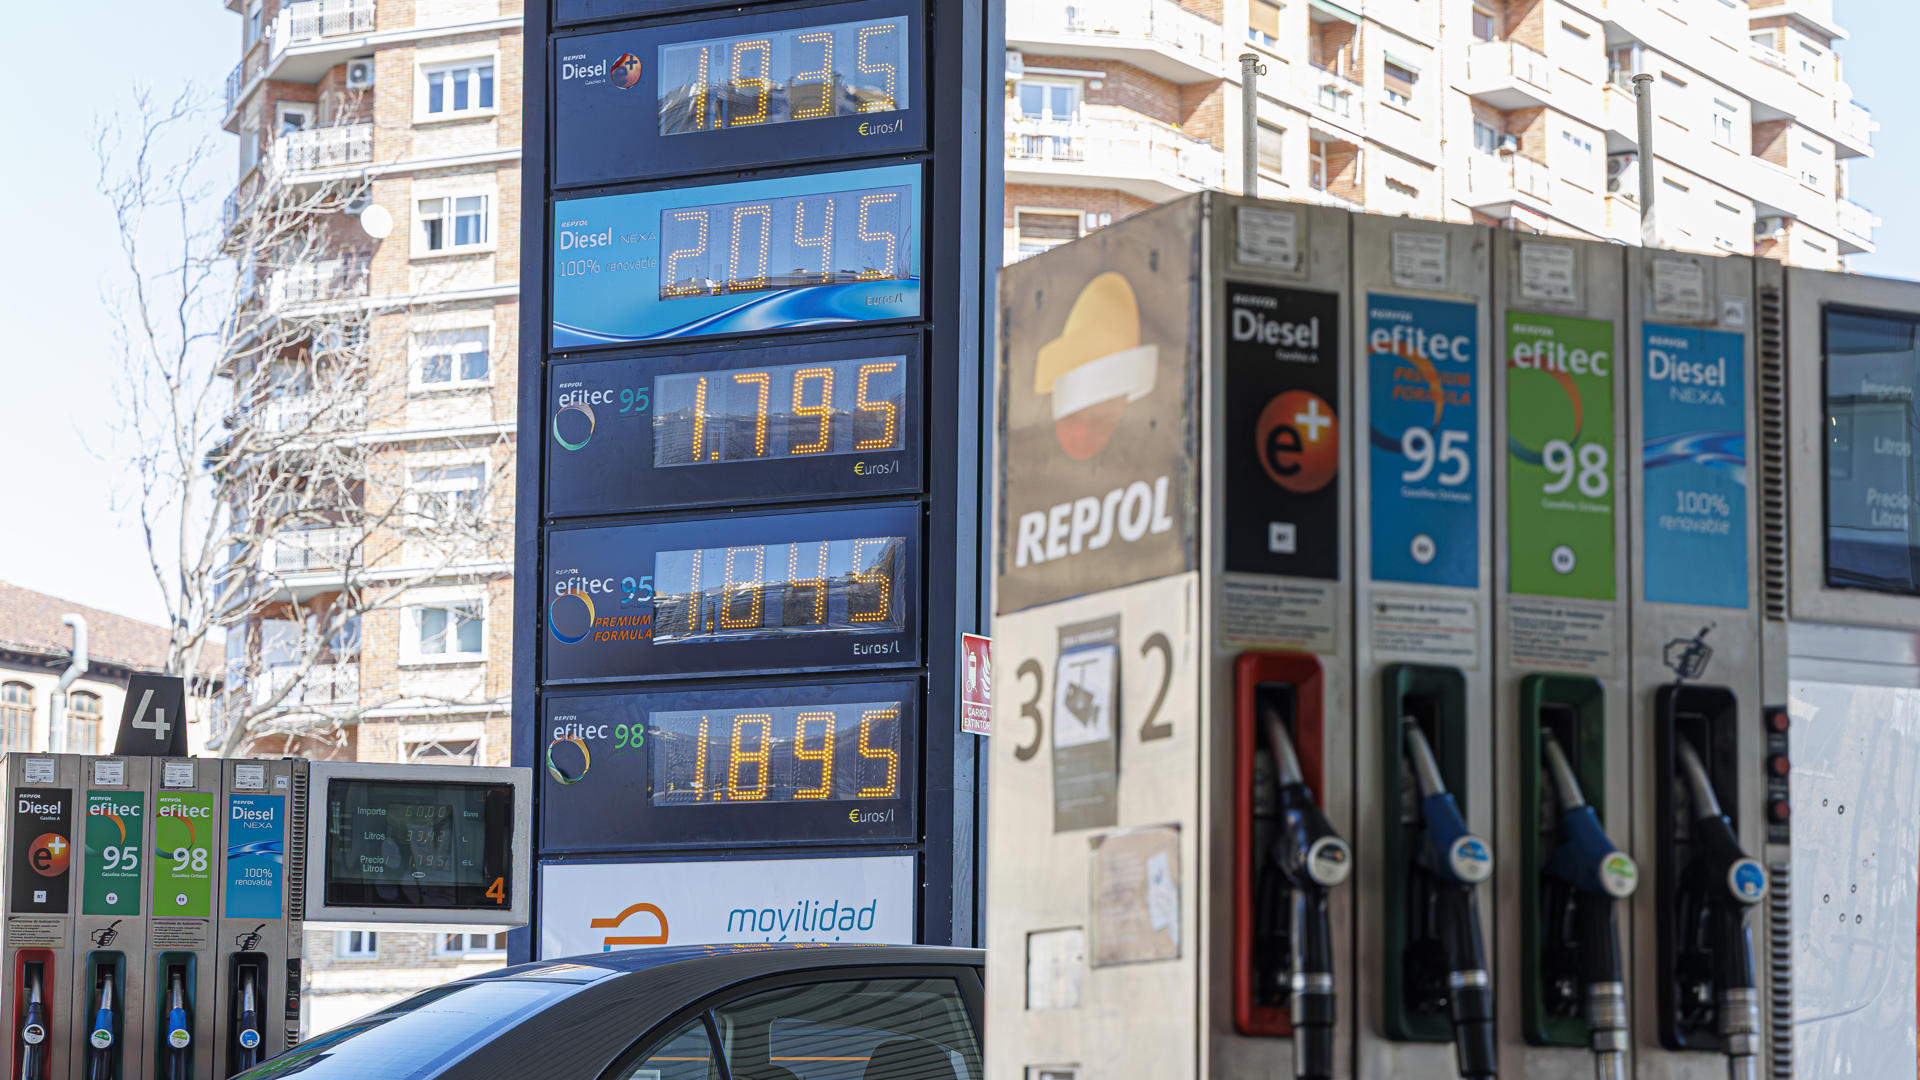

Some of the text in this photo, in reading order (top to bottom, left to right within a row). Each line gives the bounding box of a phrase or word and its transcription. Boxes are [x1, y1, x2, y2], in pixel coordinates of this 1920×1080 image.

[562, 59, 606, 80] Diesel
[561, 219, 588, 228] REPSOL
[560, 226, 657, 250] Diesel NEXA
[666, 192, 897, 296] 2.045
[560, 255, 657, 277] 100% renovable
[1232, 308, 1319, 348] Diesel
[1371, 324, 1471, 362] efitec
[1512, 340, 1609, 377] efitec
[1648, 350, 1726, 387] Diesel
[558, 387, 649, 413] efitec 95
[1669, 385, 1725, 406] NEXA
[692, 362, 897, 462] 1.795
[1401, 426, 1471, 485] 95
[1541, 440, 1609, 498] 98
[1675, 490, 1730, 517] 100%
[1015, 475, 1174, 569] REPSOL
[1659, 514, 1731, 536] renovable
[555, 575, 653, 604] efitec 95
[593, 614, 651, 629] PREMIUM
[593, 627, 653, 643] FORMULA
[1140, 632, 1174, 743] 2
[131, 688, 171, 740] 4
[967, 707, 988, 719] CARRO
[1014, 658, 1043, 762] 3
[553, 722, 645, 749] efitec 98
[964, 717, 991, 730] EXTINTOR
[695, 708, 900, 802] 1.895
[18, 800, 61, 815] Diesel
[89, 802, 140, 817] efitec
[159, 804, 210, 818] efitec
[232, 806, 274, 821] Diesel
[357, 807, 386, 816] Importe
[463, 810, 479, 818] Euros
[364, 831, 386, 841] Litros
[103, 845, 138, 870] 95
[172, 847, 208, 872] 98
[360, 855, 384, 865] Precio
[362, 865, 384, 874] Litros
[235, 878, 273, 887] renovable
[244, 867, 273, 878] 100%
[485, 876, 505, 905] 4
[727, 899, 877, 932] movilidad
